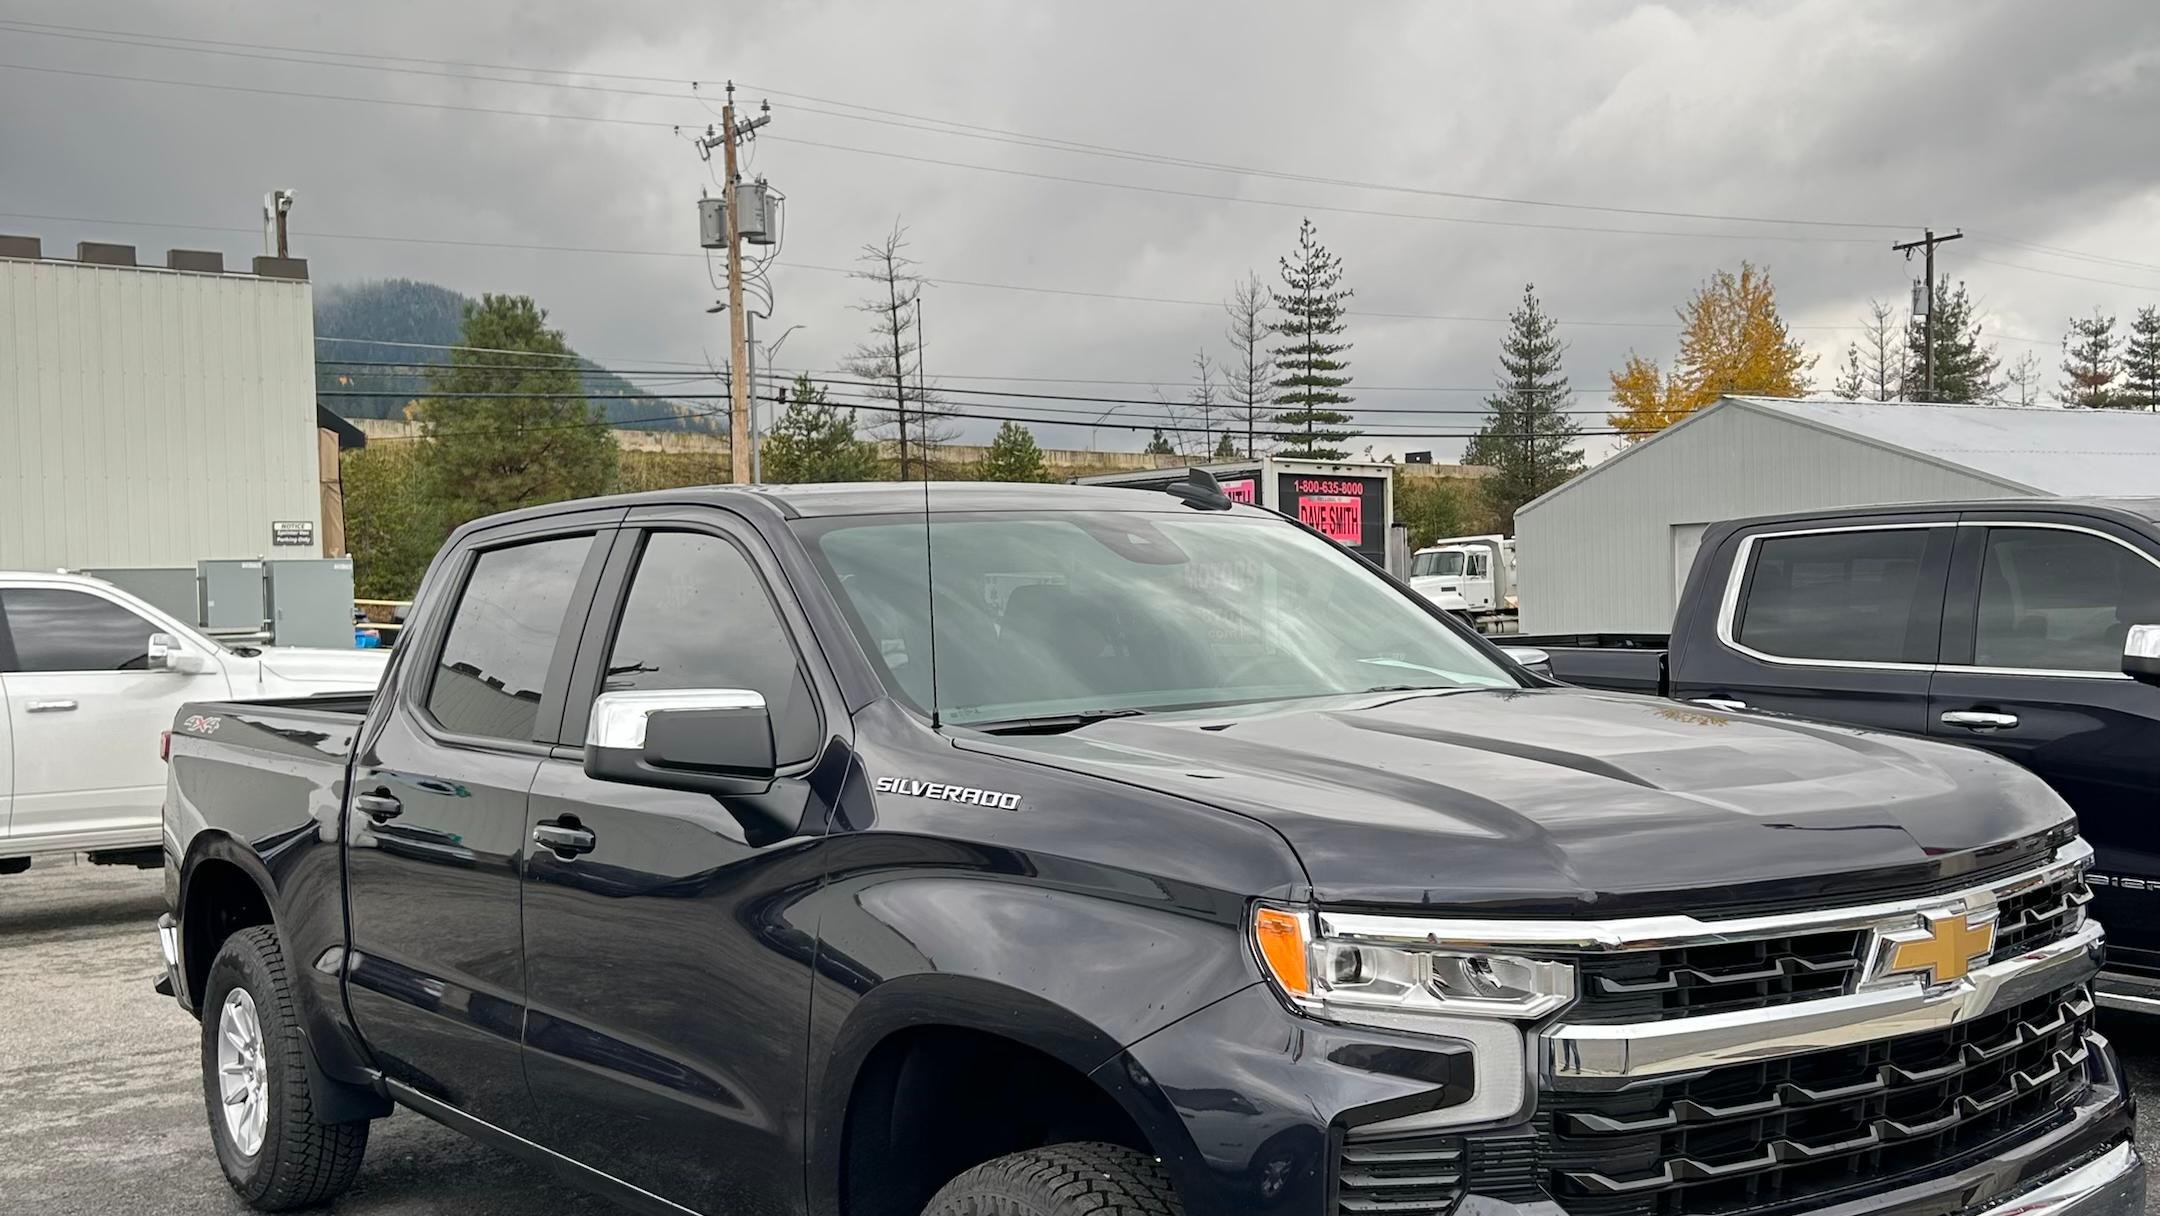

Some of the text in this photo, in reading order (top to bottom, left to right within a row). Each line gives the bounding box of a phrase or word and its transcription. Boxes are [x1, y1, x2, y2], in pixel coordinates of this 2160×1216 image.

[1294, 479, 1364, 495] 1-800-635-8000
[1301, 505, 1359, 535] DAVE SMITH
[876, 777, 1022, 811] SILVERADO
